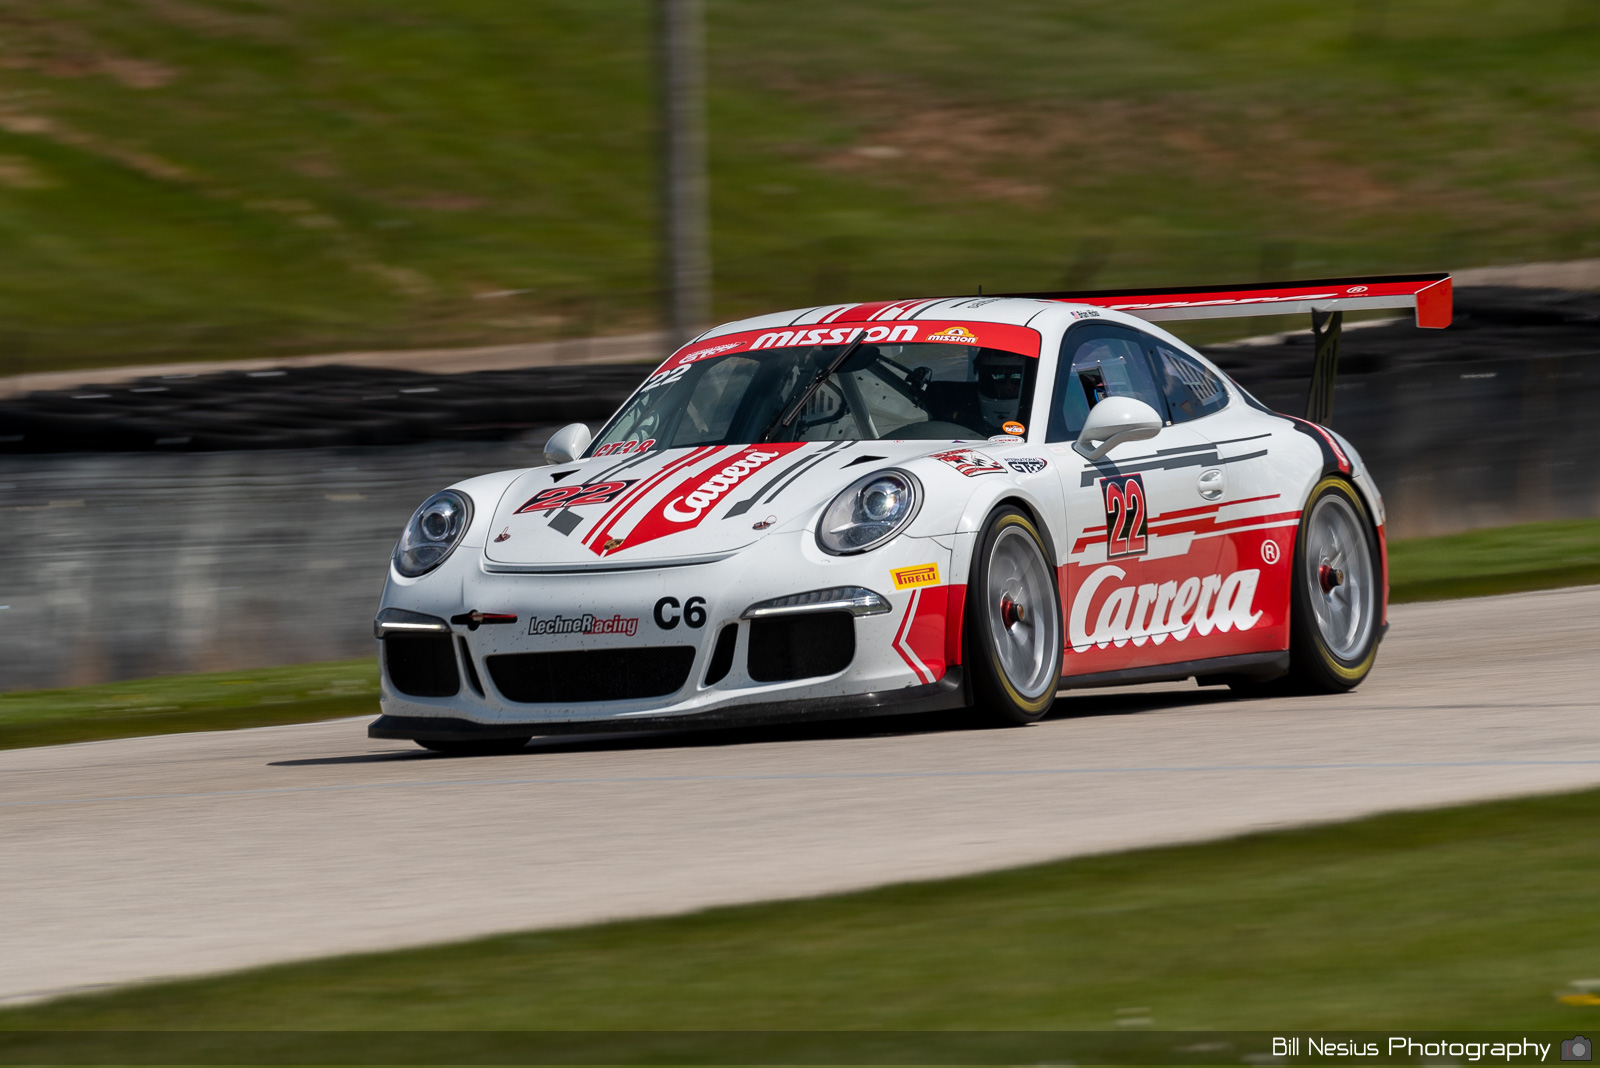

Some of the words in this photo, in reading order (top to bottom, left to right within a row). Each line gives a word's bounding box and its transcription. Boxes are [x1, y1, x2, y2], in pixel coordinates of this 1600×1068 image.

[641, 363, 692, 393] 22
[521, 481, 628, 512] 22
[663, 450, 779, 523] Carrera
[1106, 478, 1146, 557] 22
[895, 567, 936, 585] PIRELLI
[653, 596, 707, 630] C6
[1069, 565, 1264, 653] Carrera
